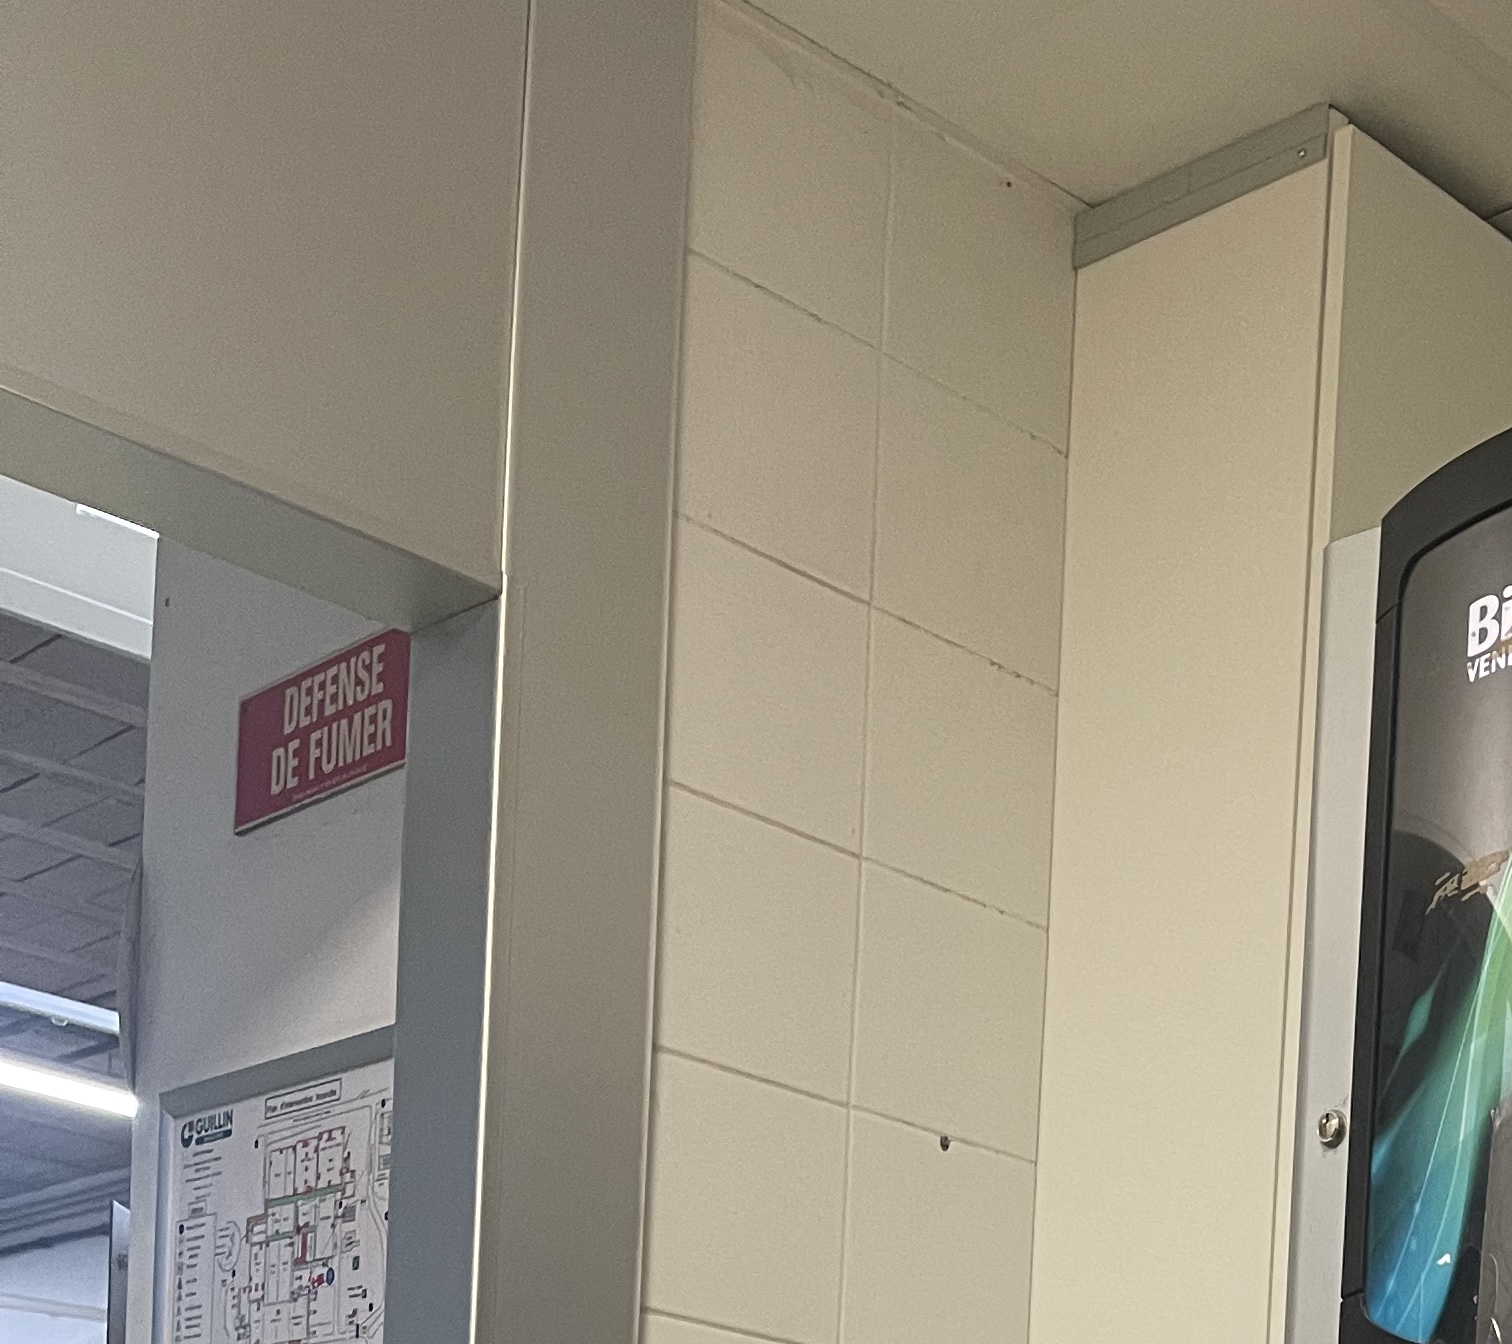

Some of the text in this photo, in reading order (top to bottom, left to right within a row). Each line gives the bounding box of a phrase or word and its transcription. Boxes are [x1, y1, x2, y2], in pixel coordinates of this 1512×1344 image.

[284, 644, 385, 736] DEFENSE
[270, 738, 300, 795] DE
[308, 699, 393, 781] FUMER
[195, 1108, 234, 1134] GUILLIN
